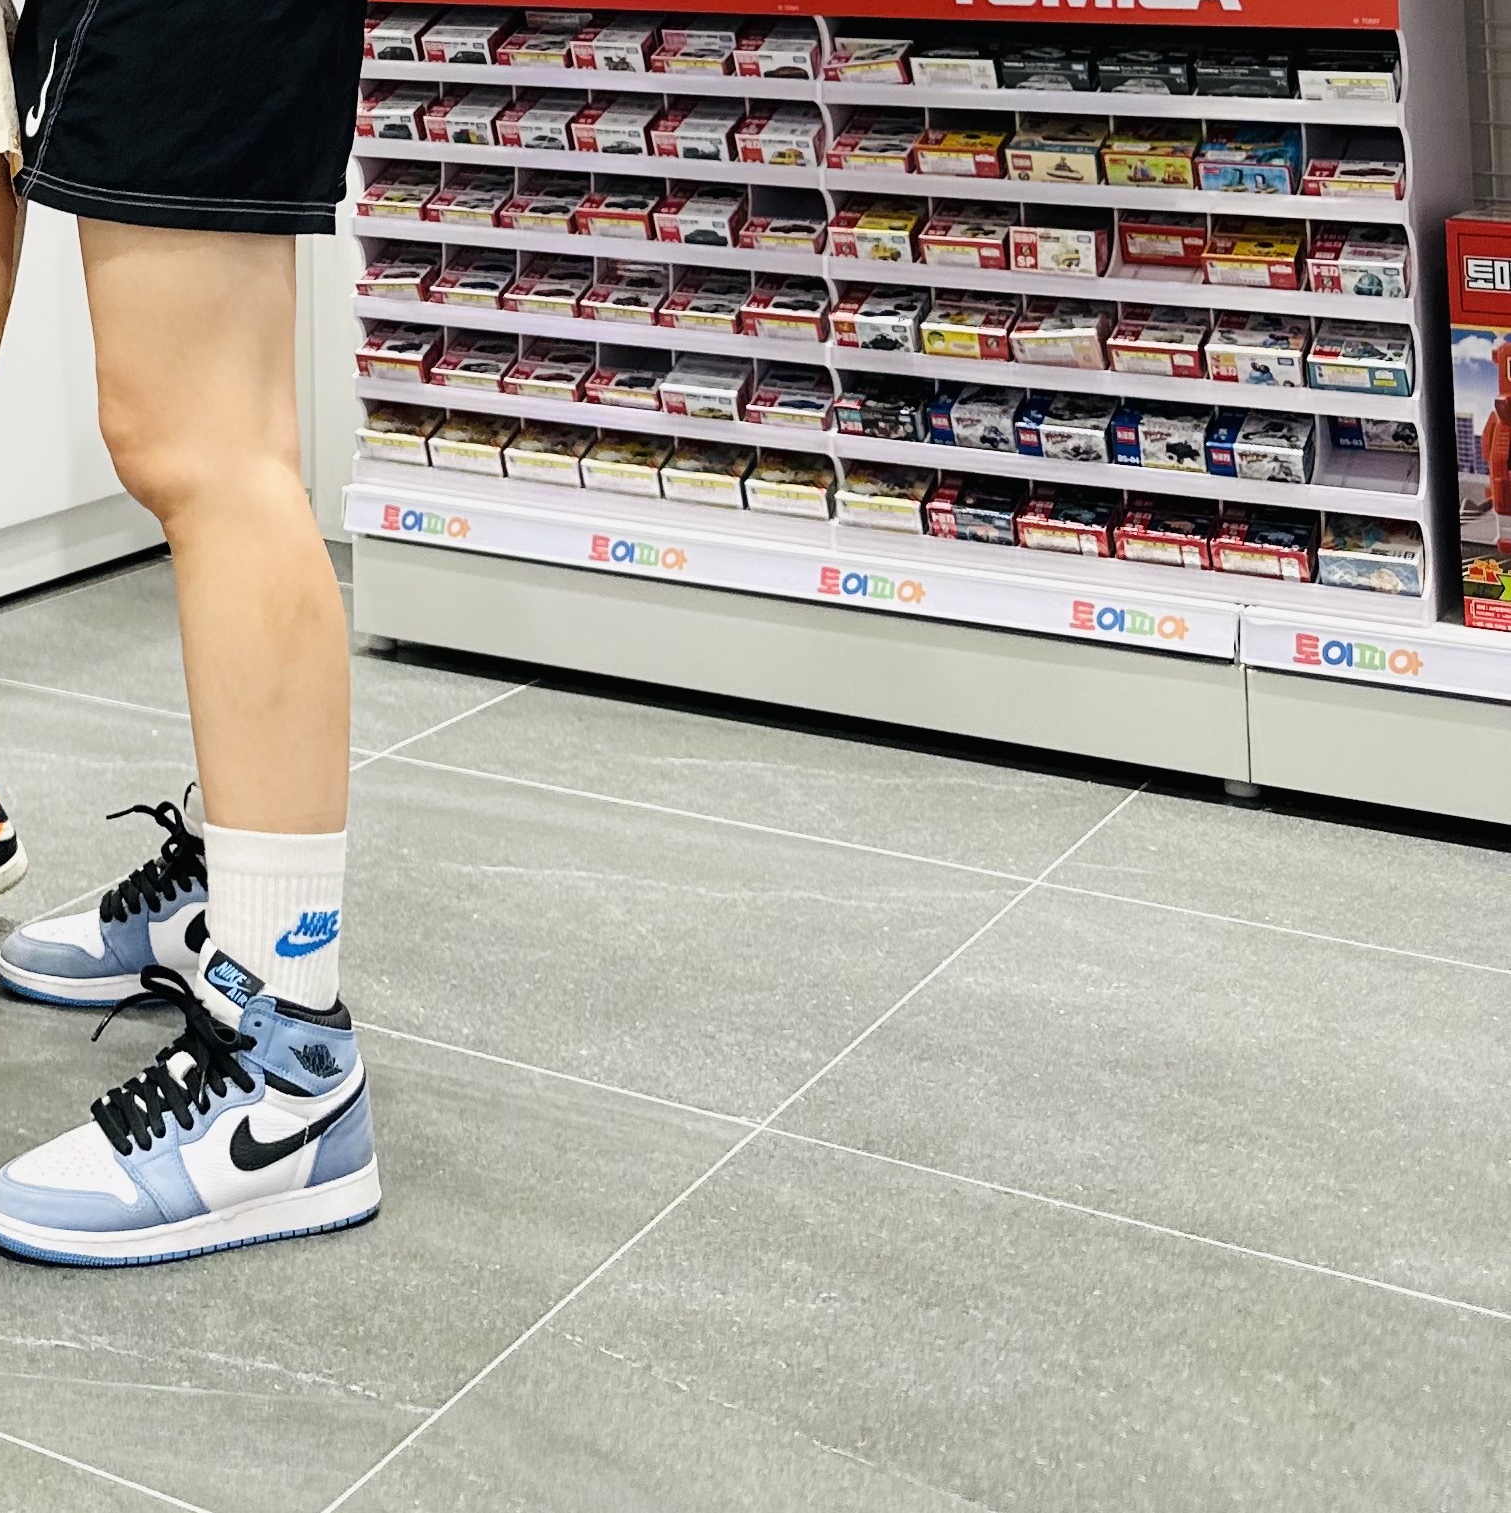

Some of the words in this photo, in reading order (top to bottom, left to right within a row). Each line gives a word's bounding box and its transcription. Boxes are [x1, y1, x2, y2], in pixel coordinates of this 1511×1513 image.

[1017, 257, 1036, 267] SP
[381, 504, 471, 539] 토이피아
[588, 534, 689, 570] 토이피아
[818, 566, 925, 604] 토이피아
[1069, 600, 1190, 641] 토이피아
[1291, 633, 1424, 678] 토이피아
[295, 909, 340, 937] NIKE
[214, 961, 247, 988] NIKE
